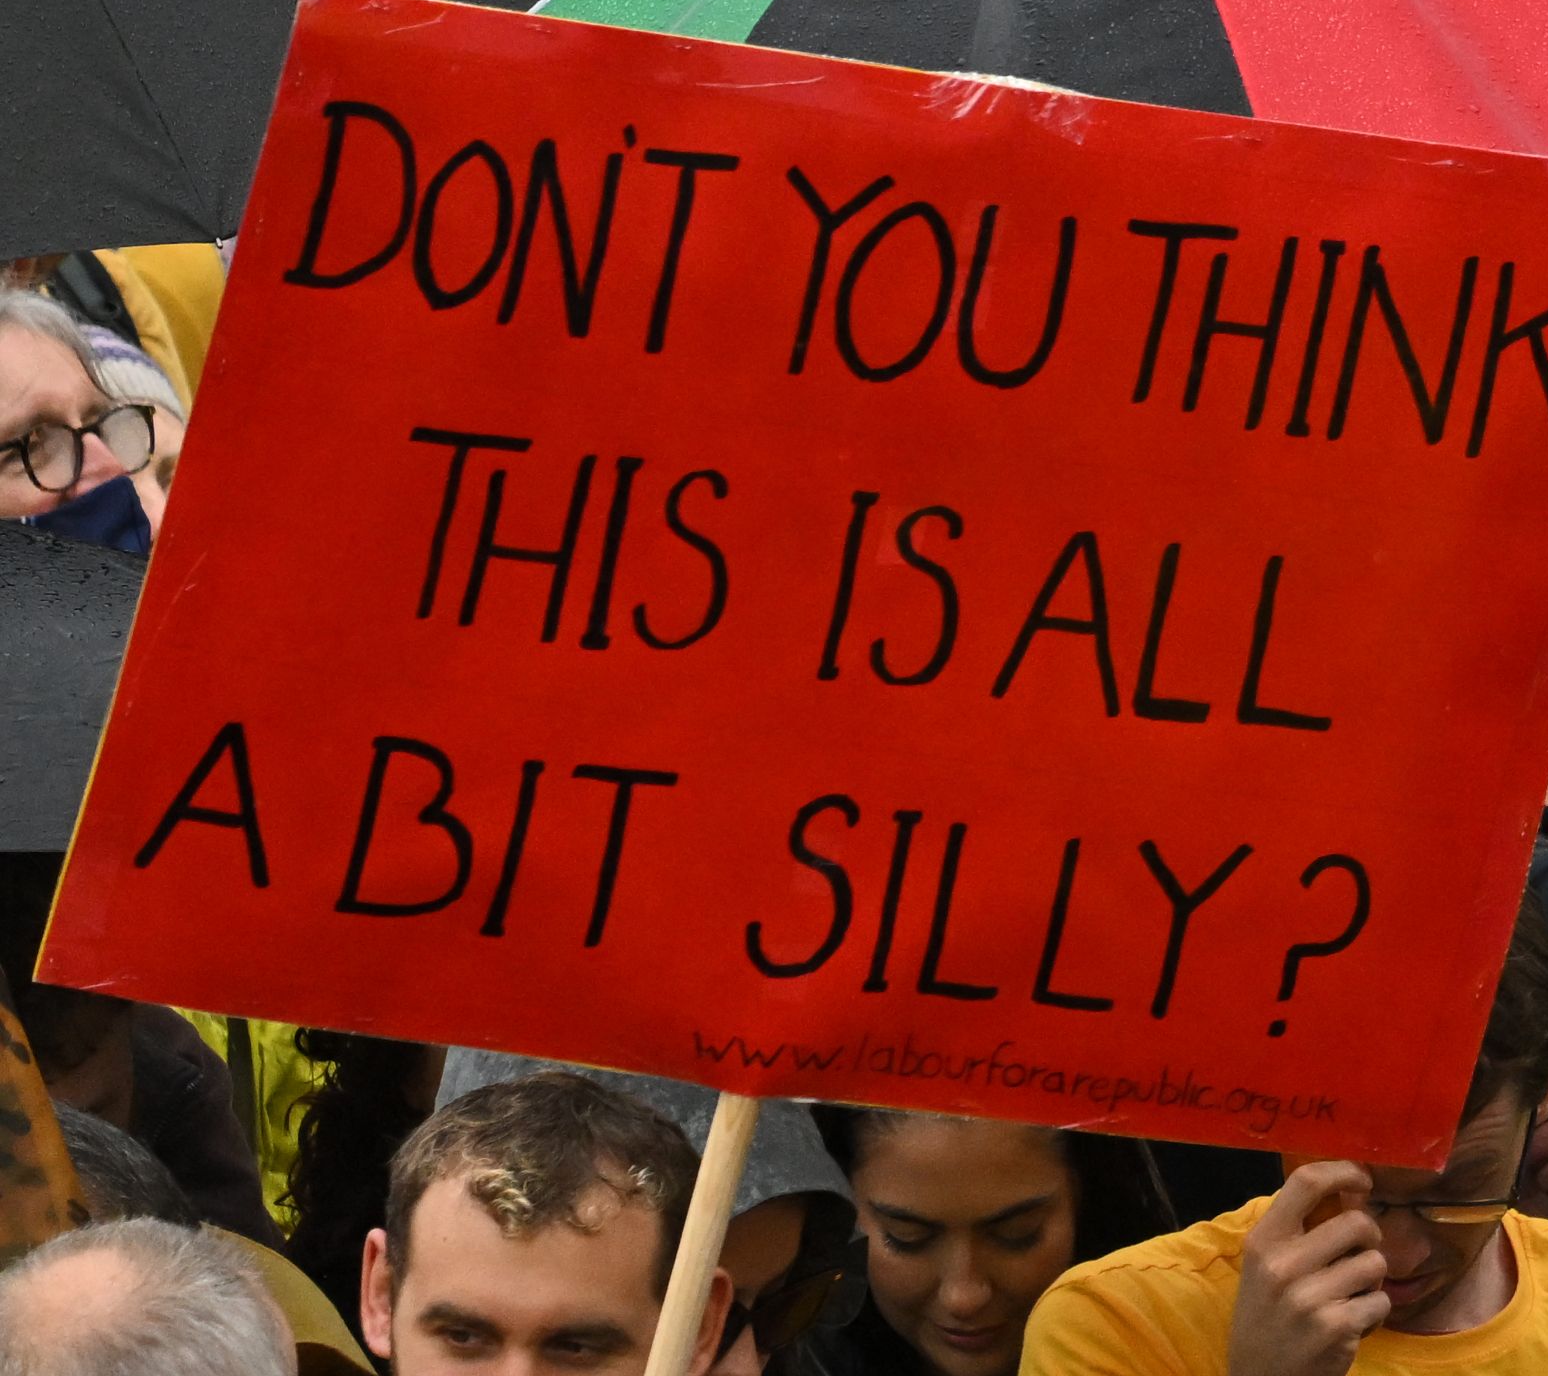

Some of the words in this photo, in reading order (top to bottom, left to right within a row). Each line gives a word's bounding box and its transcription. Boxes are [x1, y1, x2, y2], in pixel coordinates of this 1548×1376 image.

[284, 99, 741, 353] DON'T
[786, 164, 1080, 389] YOU
[410, 426, 732, 651] THIS
[817, 490, 964, 687] IS
[990, 529, 1334, 734] ALL
[133, 721, 270, 888] A
[334, 735, 681, 947] BIT
[744, 792, 1373, 1038] SILLY?
